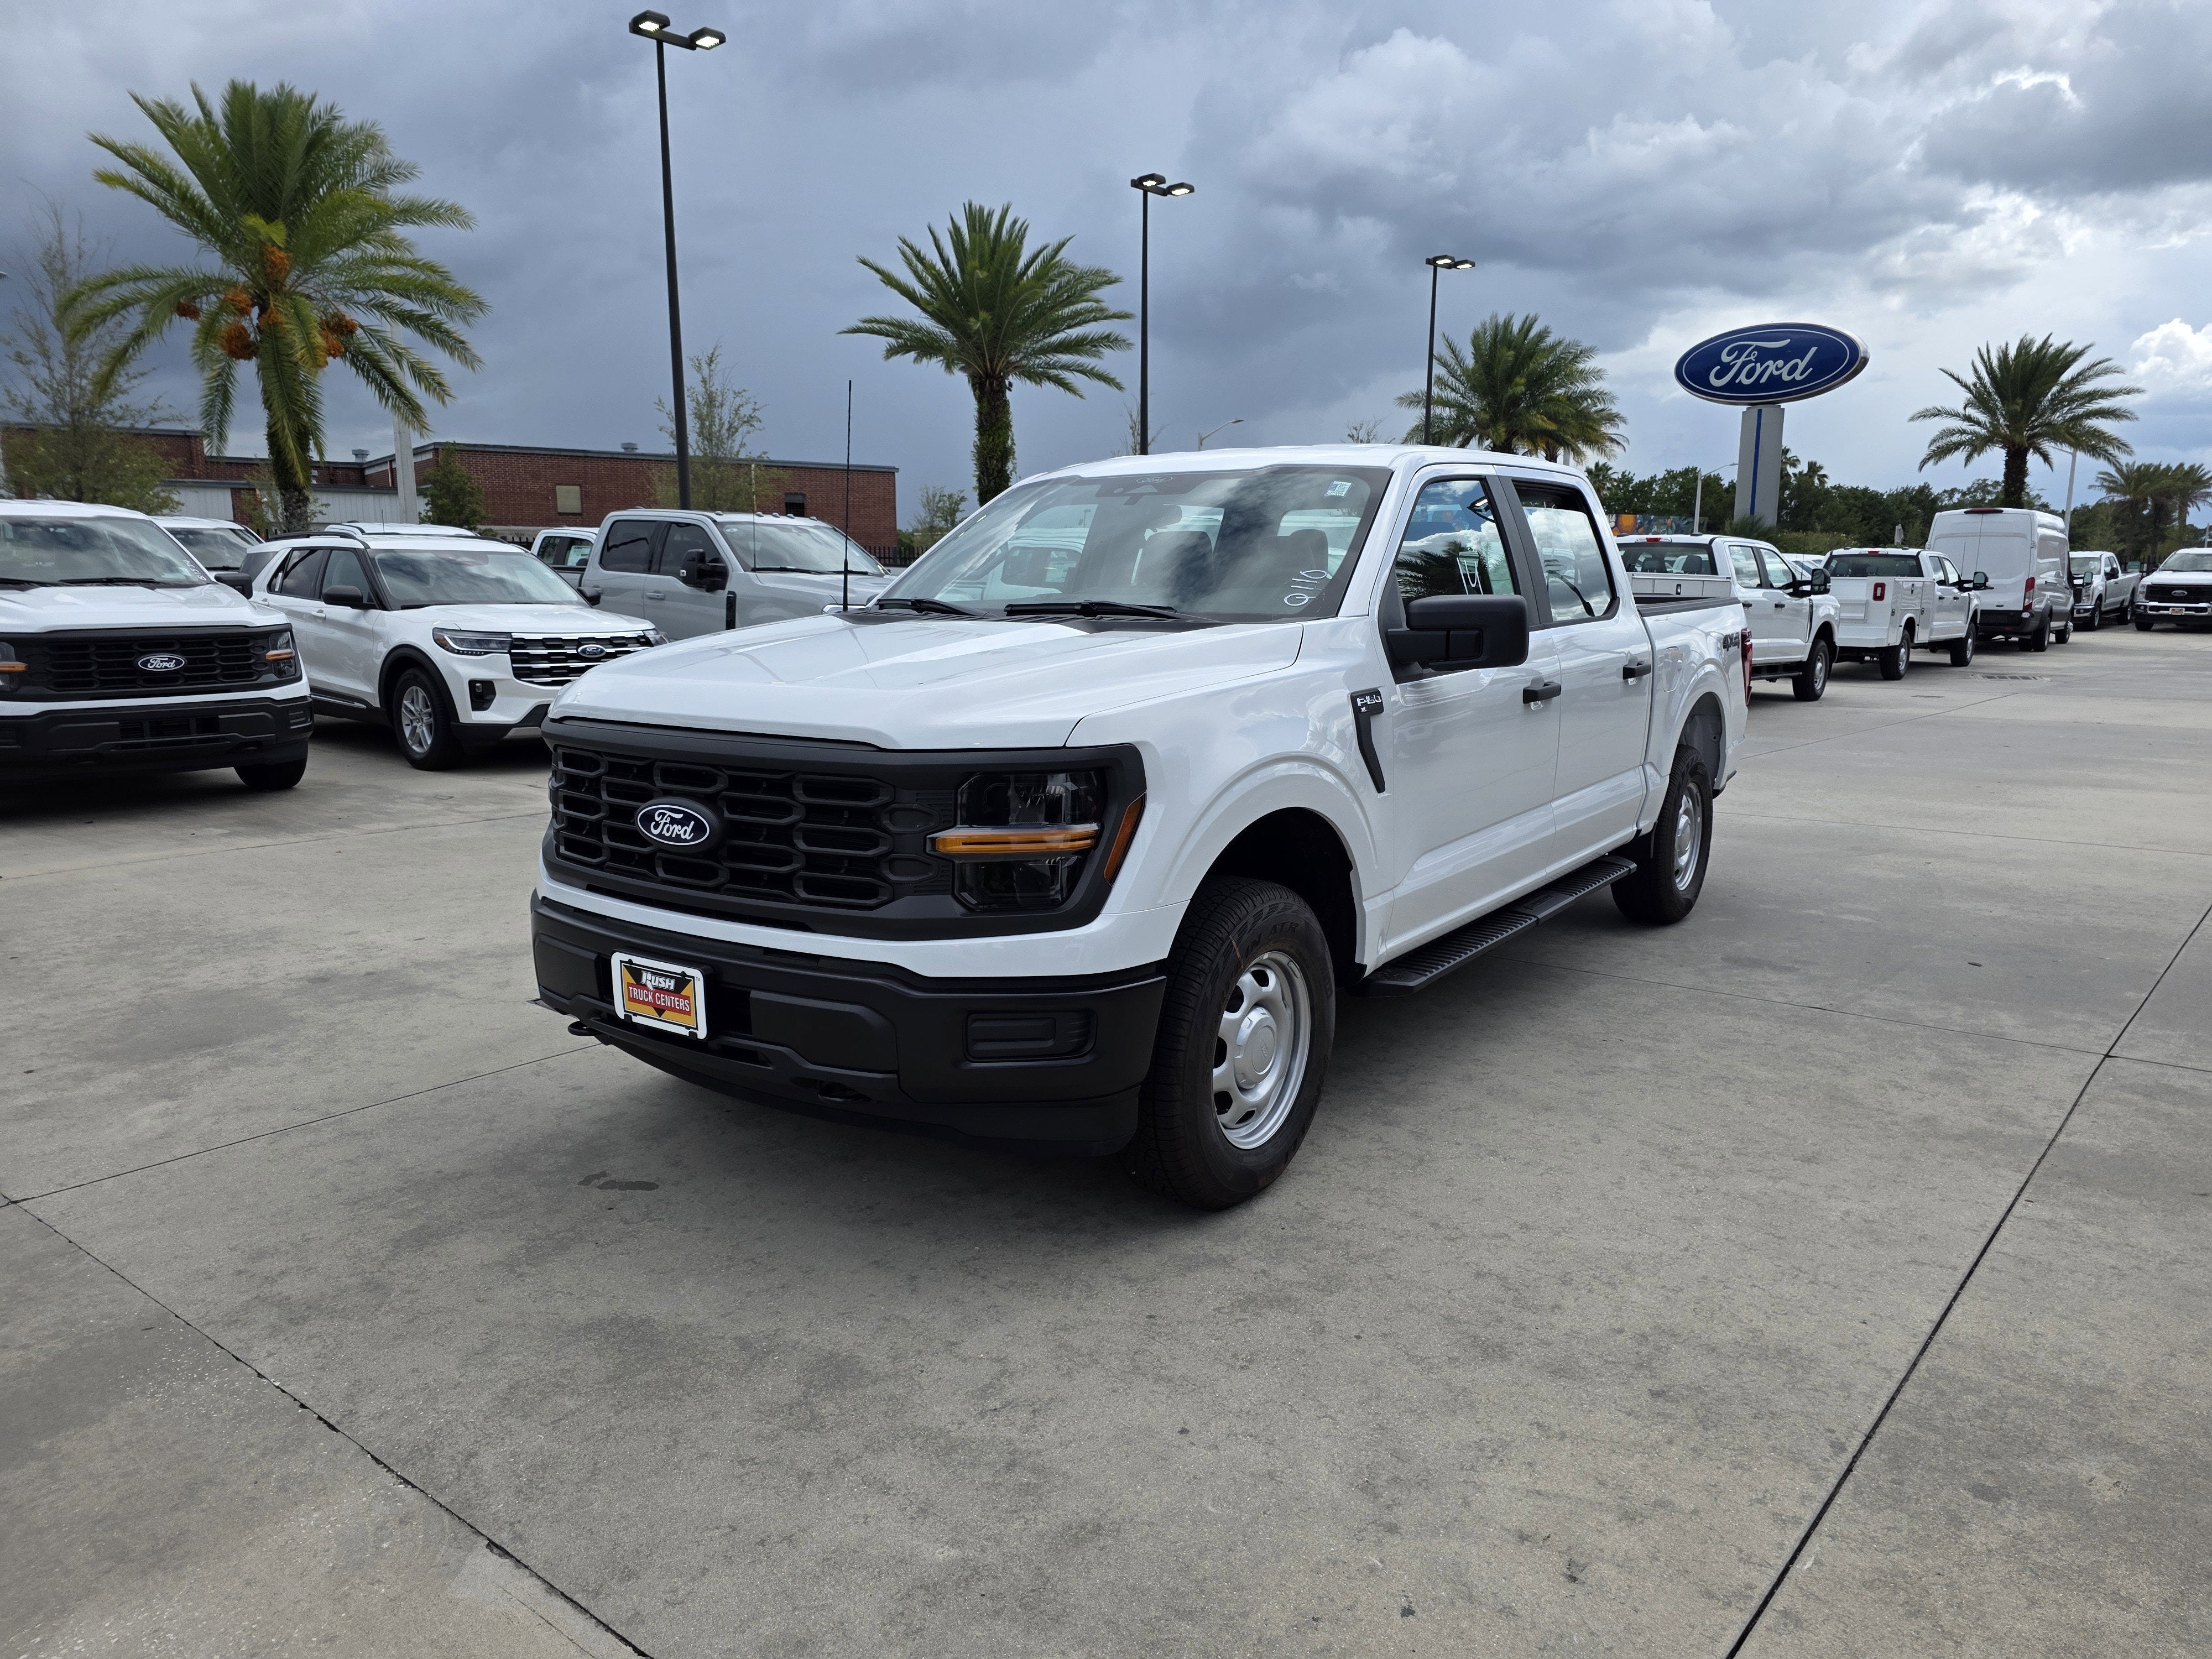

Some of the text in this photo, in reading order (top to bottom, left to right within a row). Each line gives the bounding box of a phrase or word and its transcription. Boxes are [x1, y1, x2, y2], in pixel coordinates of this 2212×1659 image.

[1709, 339, 1818, 387] Ford
[148, 658, 176, 668] Ford
[650, 810, 695, 840] Ford
[640, 970, 676, 991] RUSH
[628, 986, 690, 1012] TRUCK CENTERS
